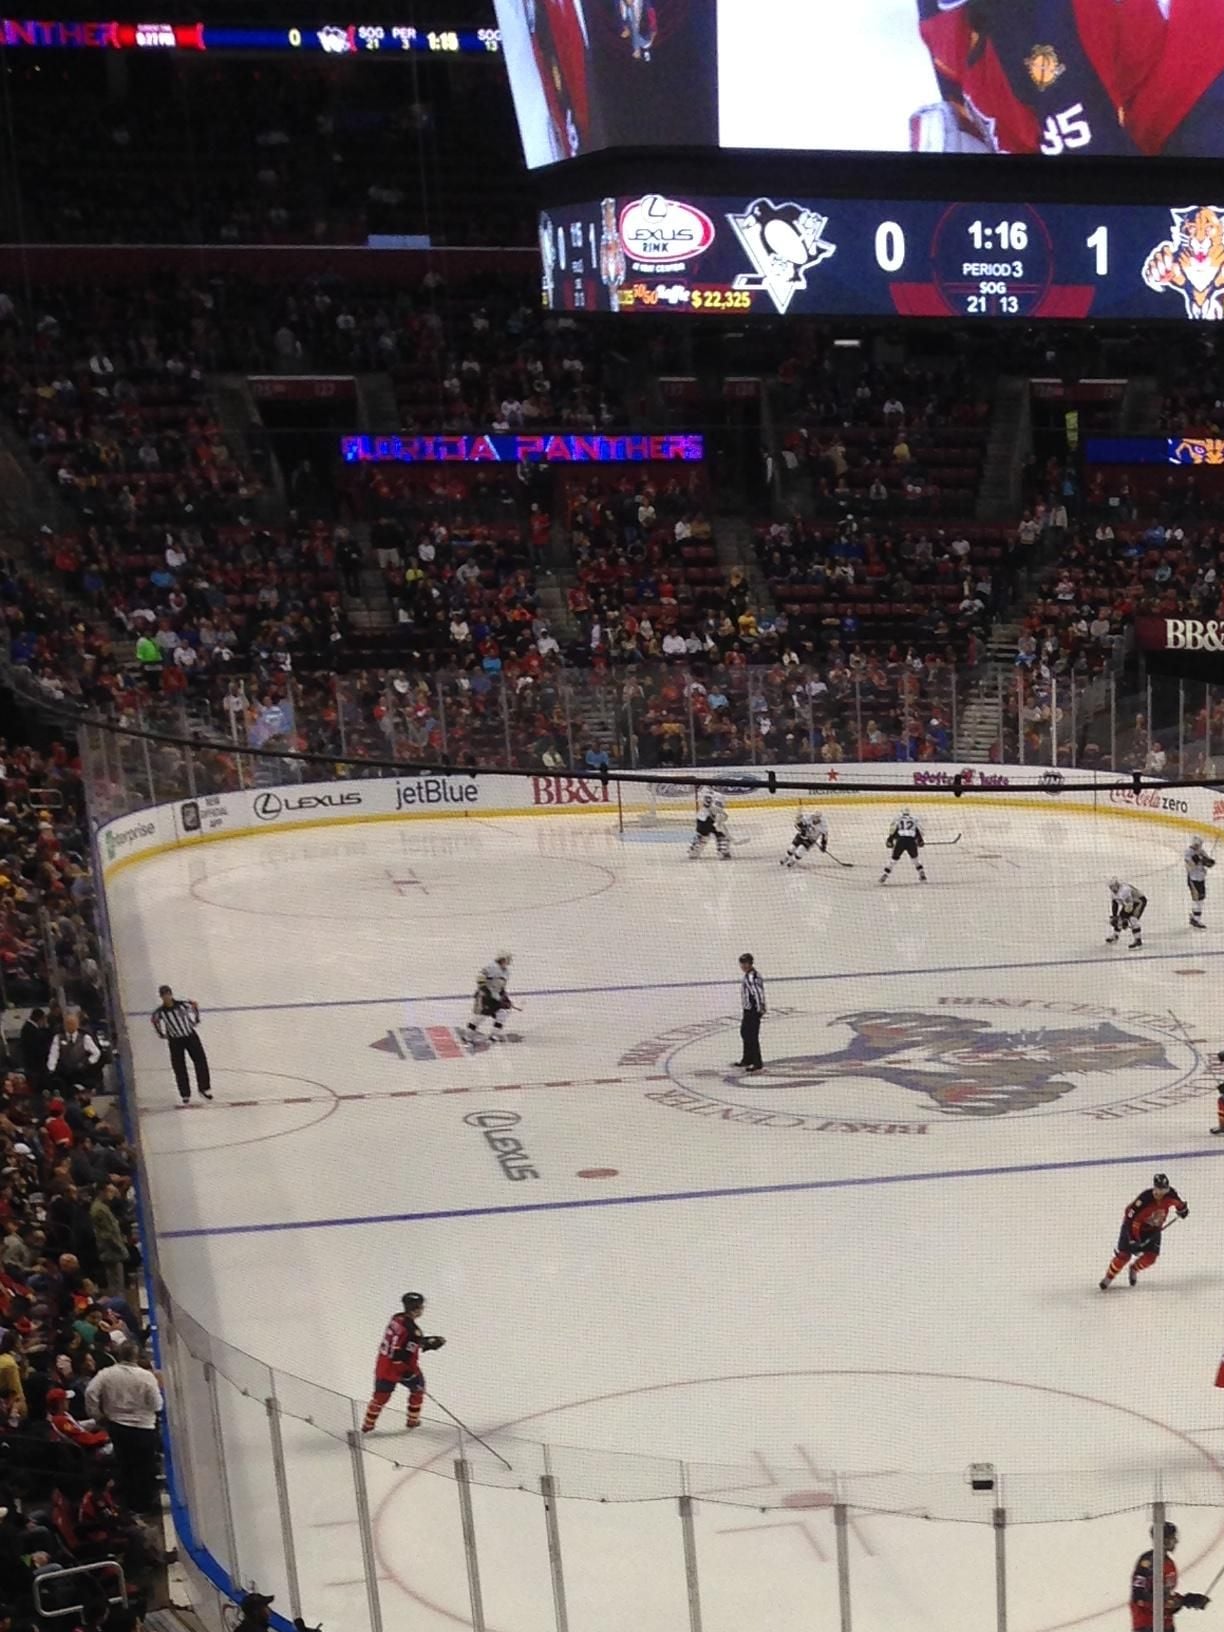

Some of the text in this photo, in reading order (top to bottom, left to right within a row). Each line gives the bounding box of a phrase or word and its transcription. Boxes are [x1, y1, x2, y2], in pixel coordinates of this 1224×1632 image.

[358, 26, 416, 39] SOG PER
[628, 228, 694, 241] LEXUS
[968, 220, 1029, 250] 1:16
[642, 242, 669, 253] RINK
[874, 220, 905, 273] 0
[1086, 225, 1108, 276] 1
[962, 260, 1024, 278] PERIOD 3
[979, 281, 1007, 294] SOG
[966, 296, 1019, 314] 21 13
[516, 434, 703, 462] PANTHERS
[284, 792, 363, 811] LEXUS
[395, 779, 478, 811] jetBlue
[1161, 796, 1188, 814] zero
[482, 1127, 541, 1182] LEXUS
